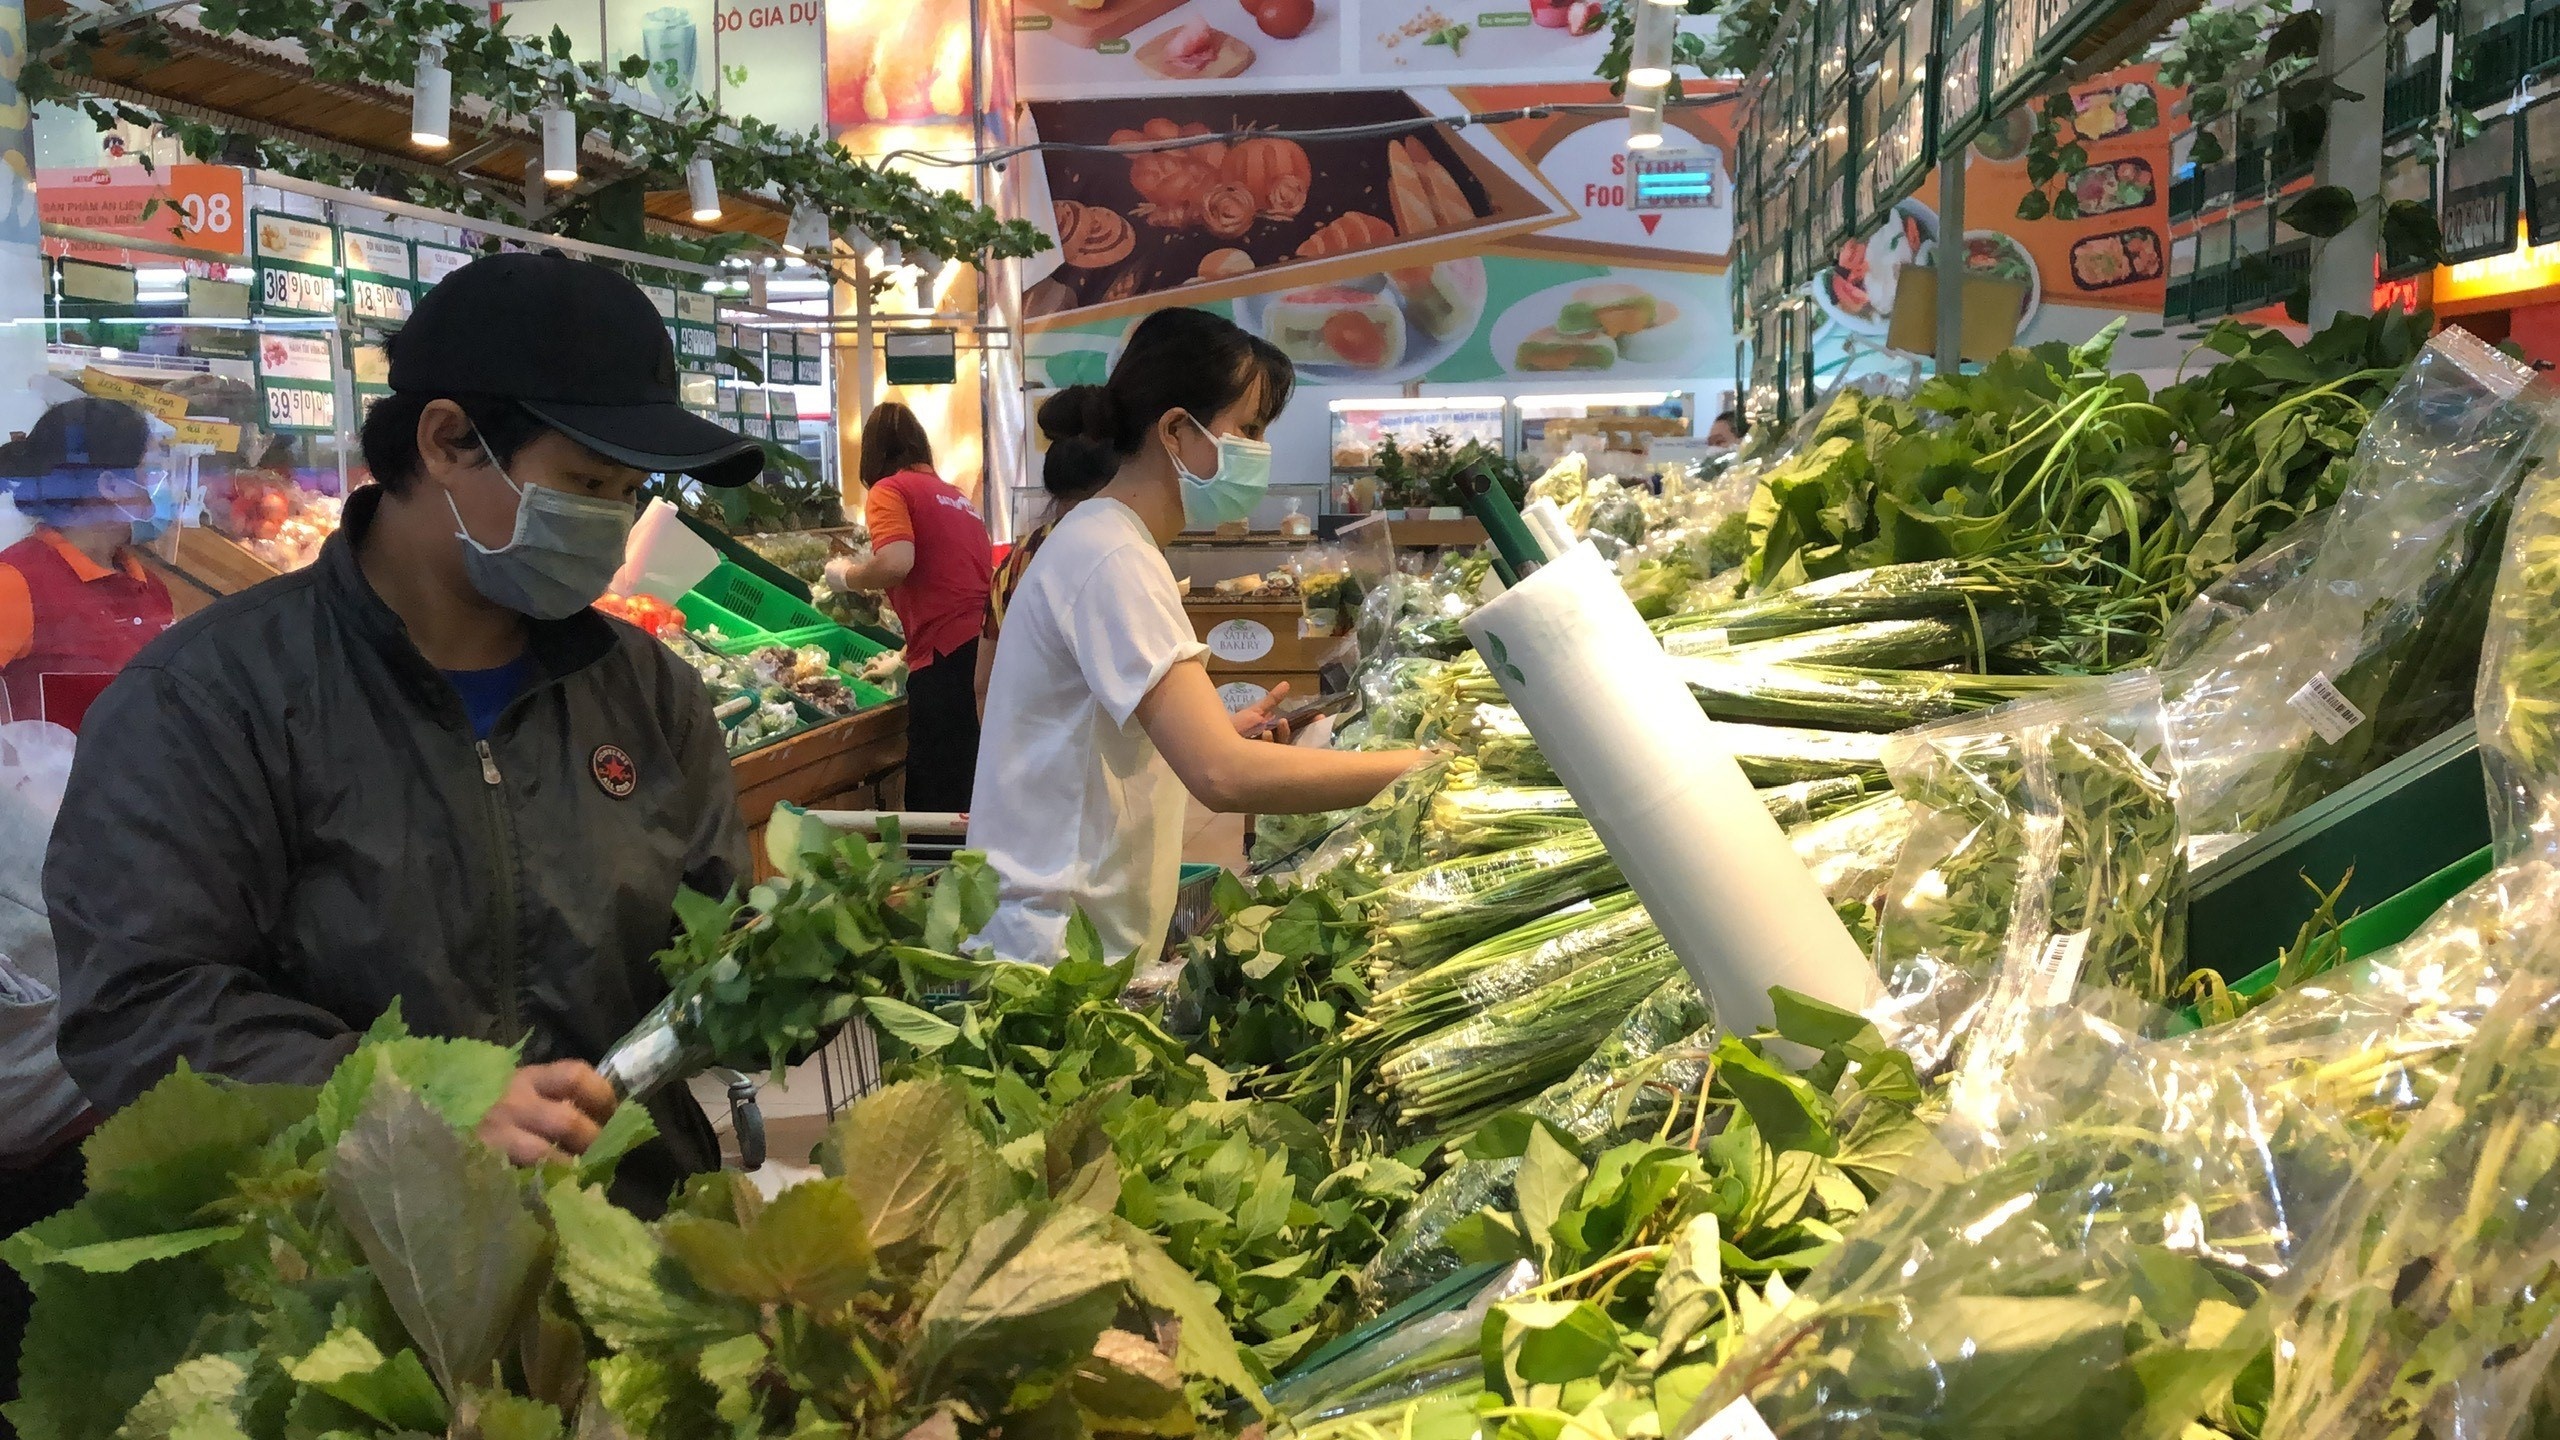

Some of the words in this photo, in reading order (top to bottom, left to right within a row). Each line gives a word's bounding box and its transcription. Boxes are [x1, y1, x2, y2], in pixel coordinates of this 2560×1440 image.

[749, 5, 785, 29] GIA
[1584, 183, 1638, 208] FOO
[181, 192, 232, 234] 08
[1219, 640, 1260, 651] BAKERY
[1223, 631, 1257, 640] SATRA
